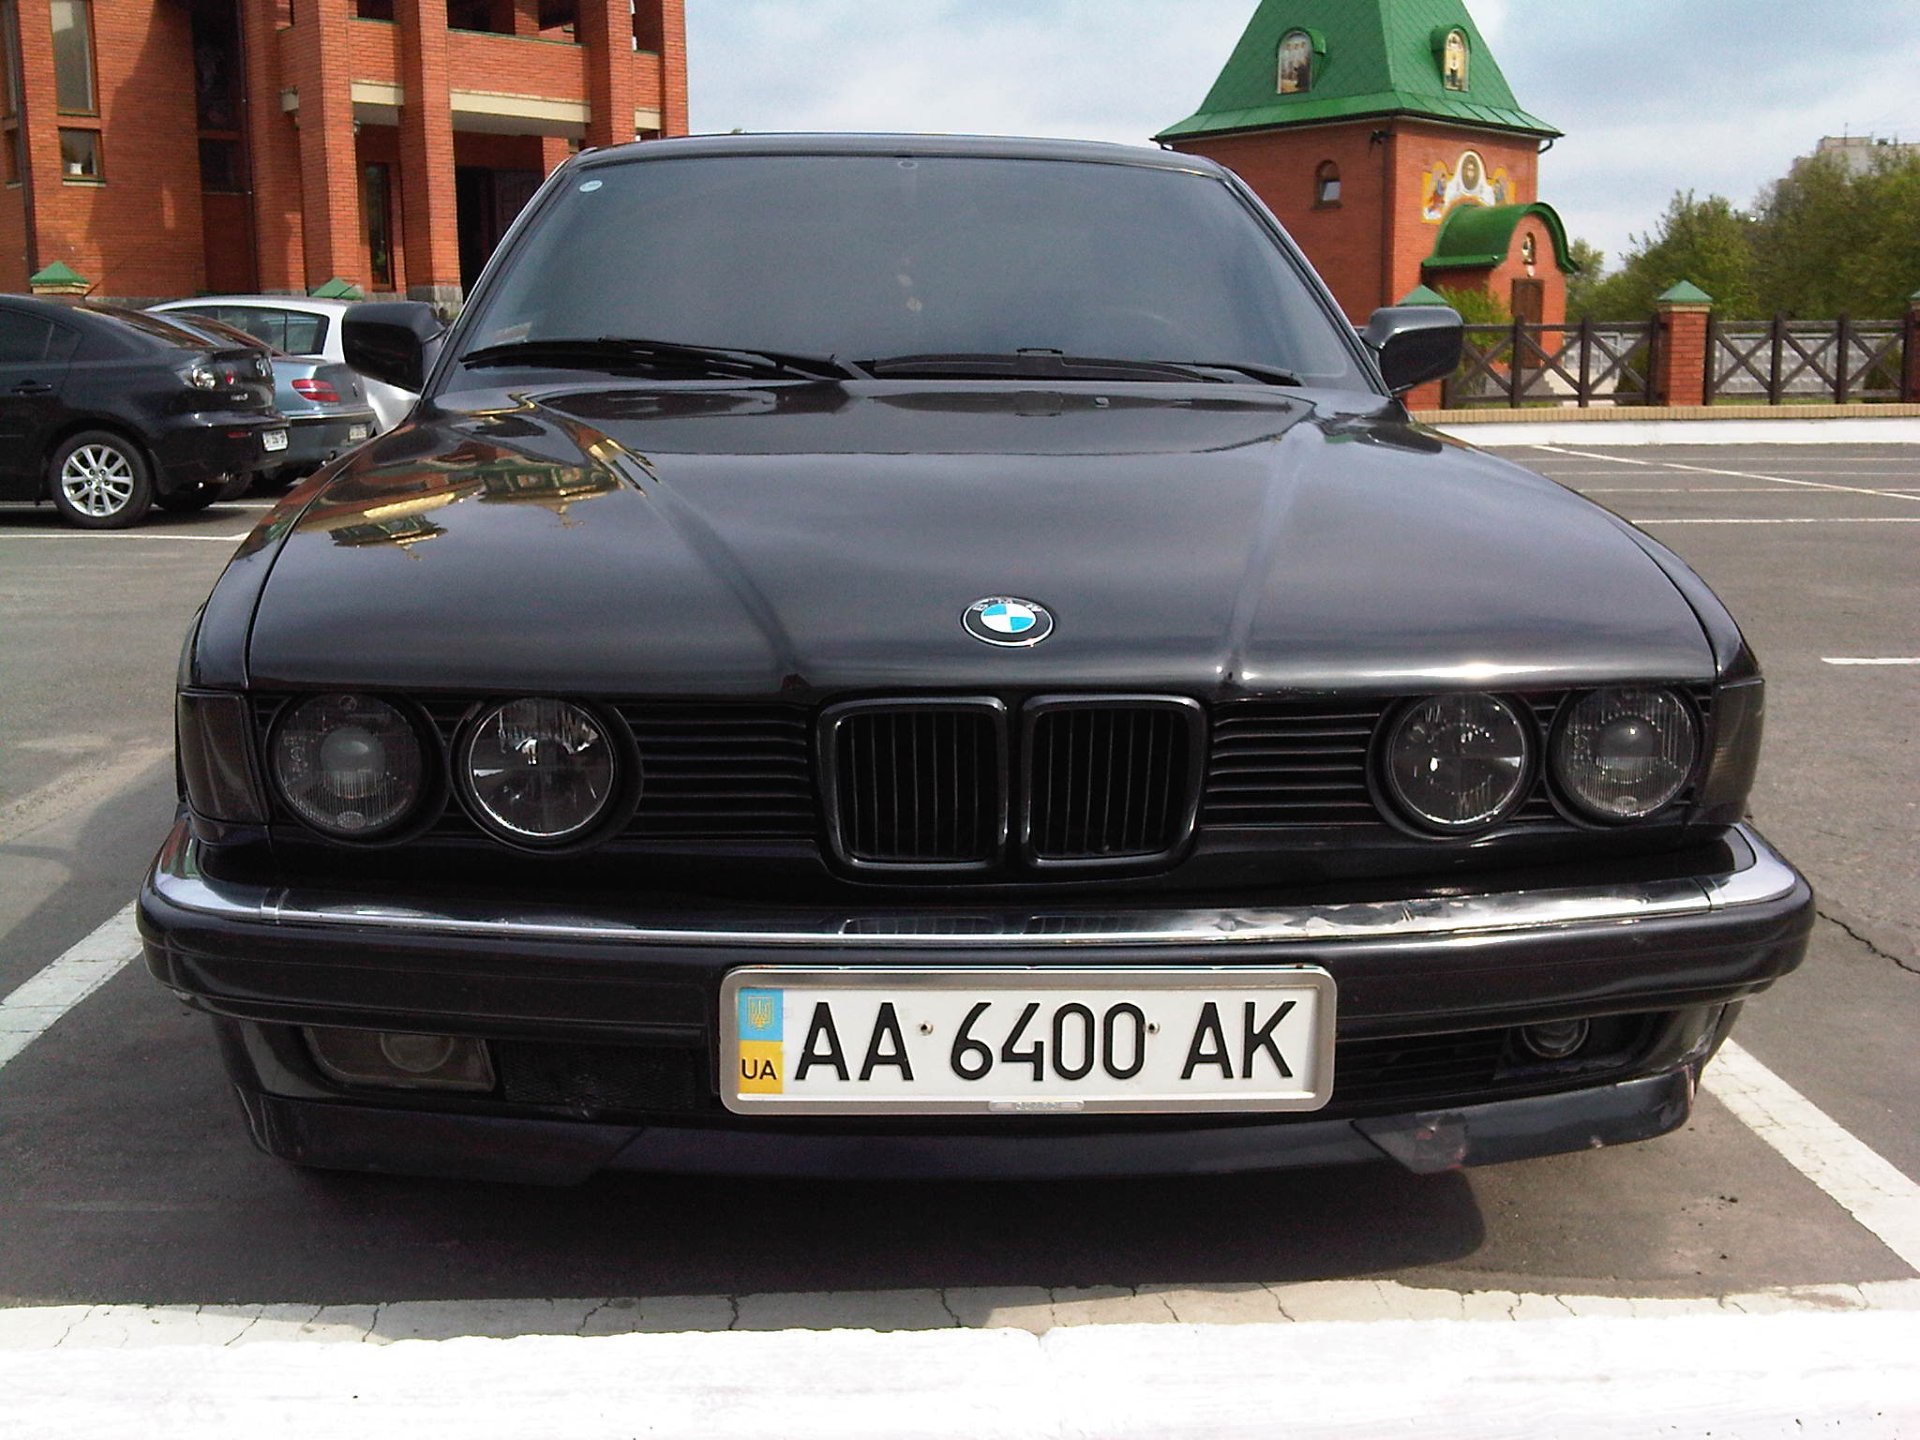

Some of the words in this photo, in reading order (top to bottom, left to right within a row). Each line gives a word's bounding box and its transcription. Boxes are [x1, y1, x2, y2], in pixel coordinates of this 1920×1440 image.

[795, 1002, 914, 1081] AA
[950, 1002, 1145, 1081] 6400
[1180, 1001, 1297, 1080] AK
[741, 1058, 777, 1080] UA
